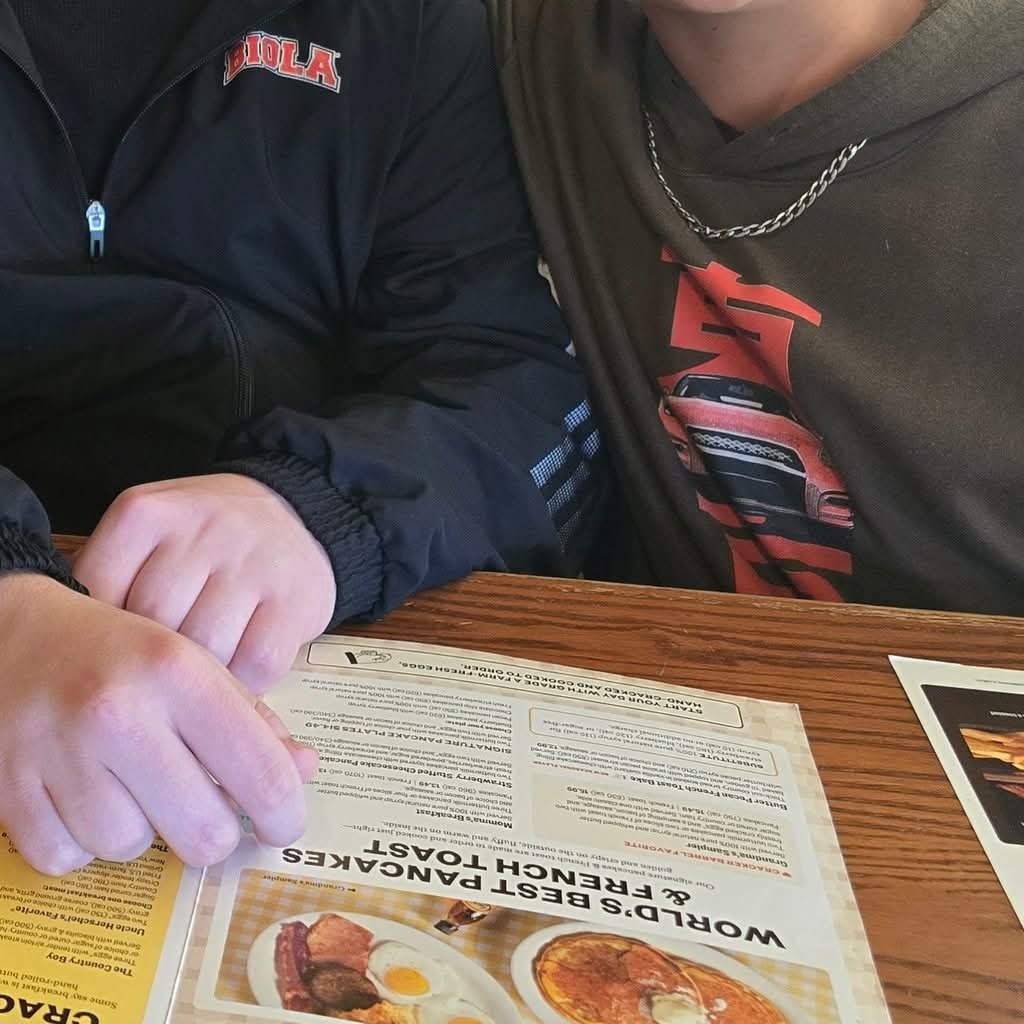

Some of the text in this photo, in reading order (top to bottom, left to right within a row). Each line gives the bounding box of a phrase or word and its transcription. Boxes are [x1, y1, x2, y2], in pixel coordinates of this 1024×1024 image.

[224, 31, 341, 93] BIOLA
[399, 661, 433, 671] EGGS,
[460, 664, 504, 675] ORDER.
[435, 666, 511, 682] FARM-FRESH
[524, 674, 575, 686] COOKED
[524, 680, 565, 691] GRADE
[576, 682, 601, 690] AND
[567, 687, 600, 697] WITH
[602, 693, 625, 701] DAY
[604, 687, 702, 708] HAND-CRACKED
[628, 697, 661, 707] YOUR
[663, 703, 703, 714] START
[342, 726, 385, 736] PLATES
[387, 732, 443, 744] PANCAKE
[445, 739, 512, 754] SIGNATURE
[536, 742, 558, 750] 12.99
[359, 761, 416, 774] Cheesecake
[417, 769, 453, 779] Stuffed
[456, 773, 512, 789] Strawberry
[630, 776, 788, 811] Butter Pecan French Toast Bake
[416, 808, 513, 829] Momma's Breakfast
[624, 841, 780, 874] CRACKER BARREL FAVORITE
[685, 843, 788, 868] Grandma's Sampler
[363, 840, 691, 906] & FRENCH TOAST
[283, 848, 785, 949] WORLD'S BEST PANCAKES
[60, 914, 114, 930] Herschel's
[115, 924, 145, 936] Uncle
[46, 952, 132, 977] The Country Boy
[10, 981, 20, 989] is
[20, 974, 78, 991] hand-rolled
[21, 983, 69, 999] breakfast
[73, 993, 88, 1001] say
[89, 997, 118, 1009] Some
